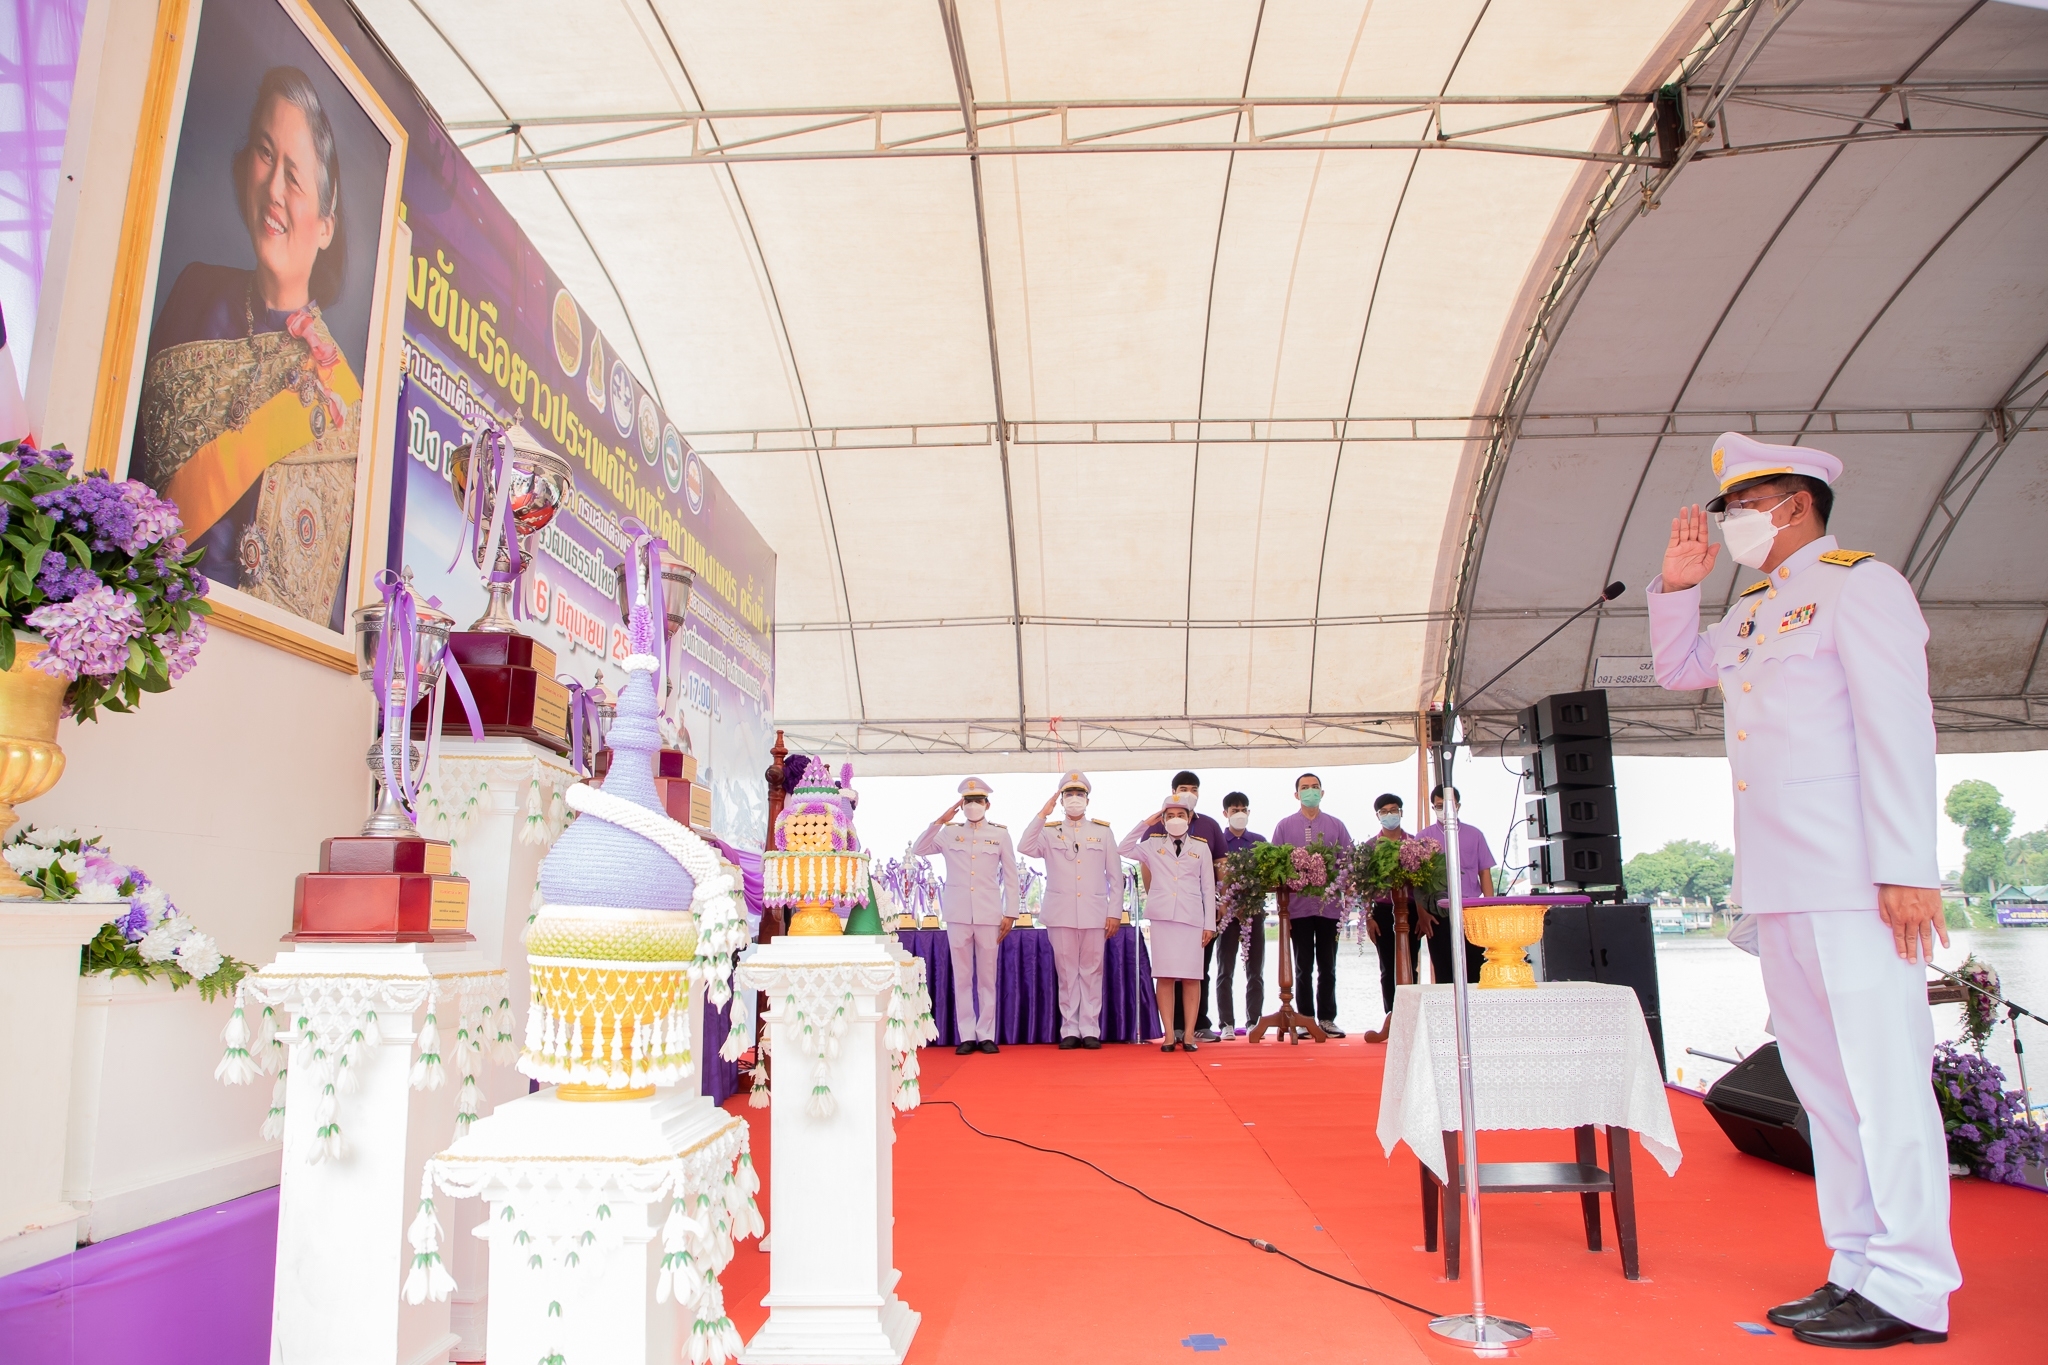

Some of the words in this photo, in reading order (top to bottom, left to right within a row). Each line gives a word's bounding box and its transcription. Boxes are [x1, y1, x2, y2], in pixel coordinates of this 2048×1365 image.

[533, 580, 548, 614] 6
[556, 593, 605, 650] มิถุนายน
[612, 629, 634, 661] 25
[689, 674, 711, 710] 17.00
[740, 575, 764, 633] ครั้งที่
[765, 614, 771, 640] 2
